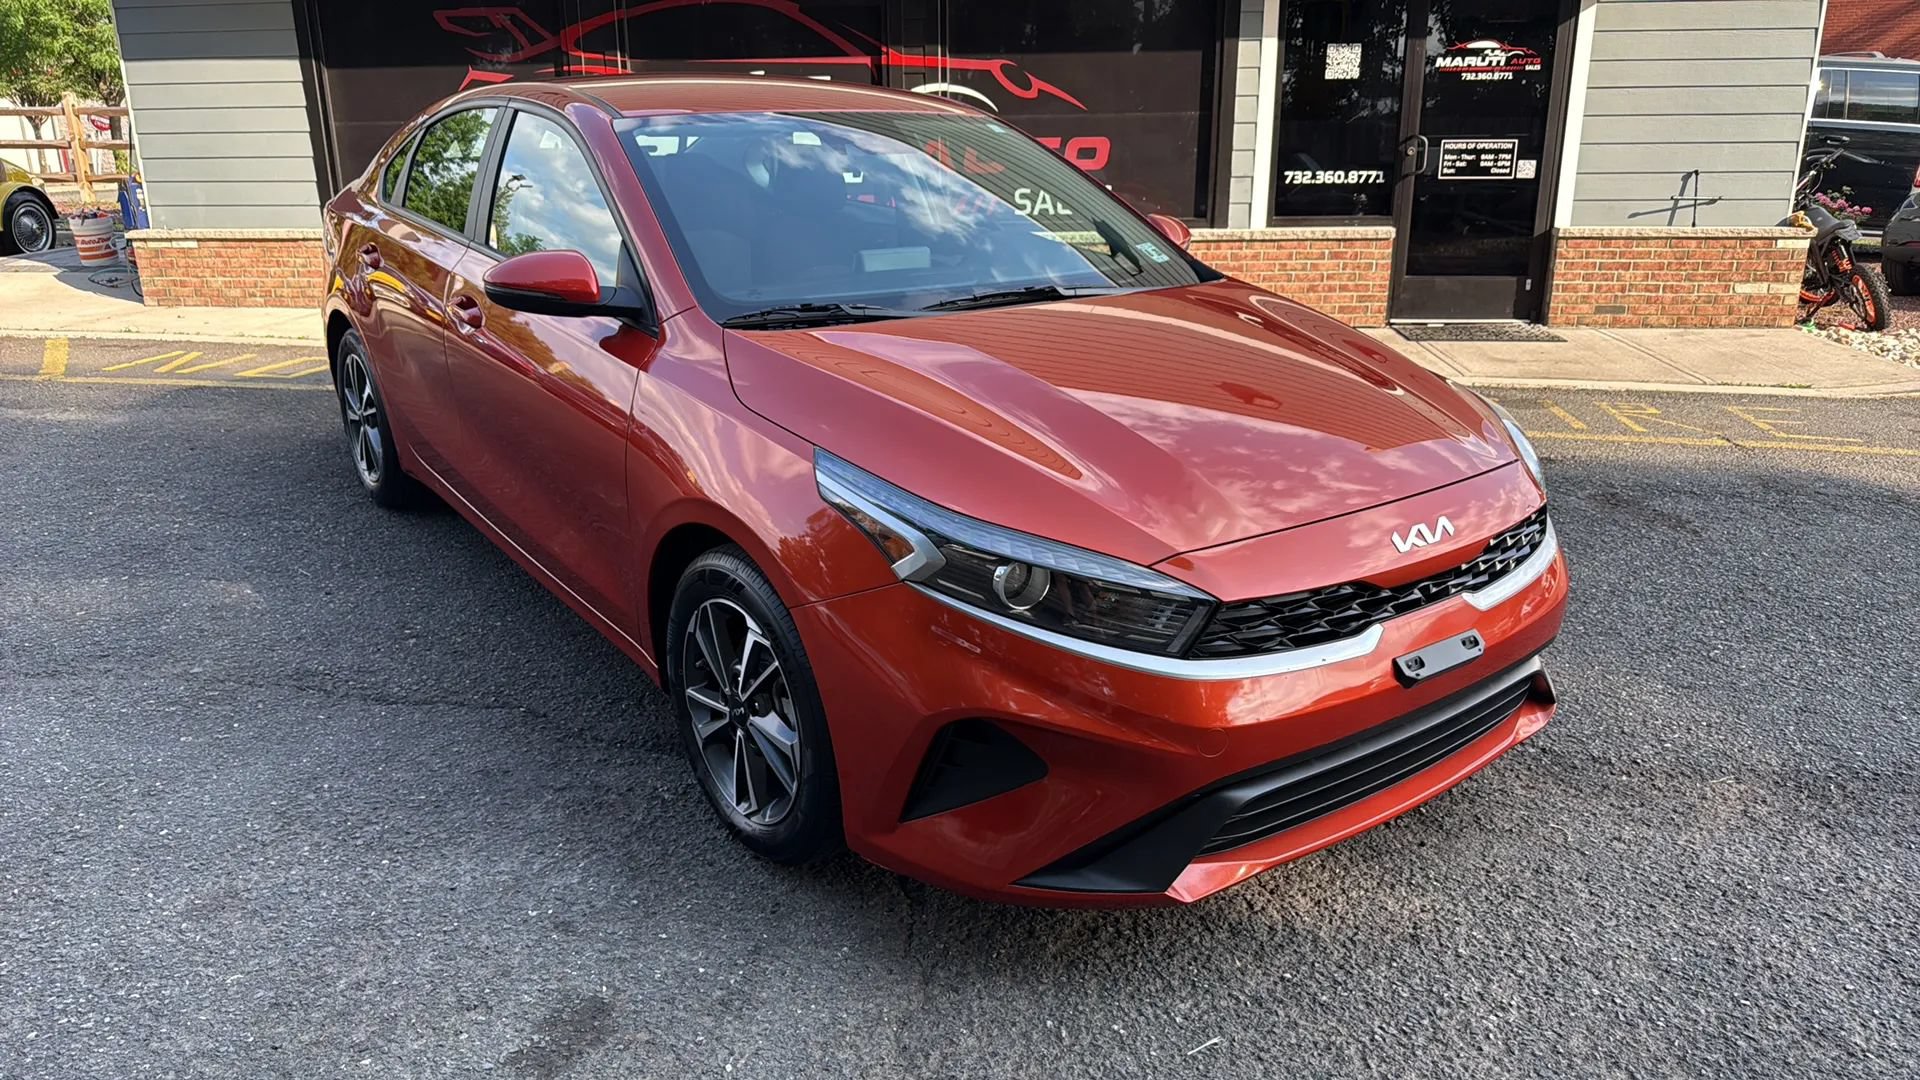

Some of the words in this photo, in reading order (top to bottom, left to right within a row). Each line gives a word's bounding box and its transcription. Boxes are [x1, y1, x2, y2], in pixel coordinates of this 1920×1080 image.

[1435, 56, 1506, 67] MARUTI
[1461, 72, 1513, 80] 732.360.8771
[922, 136, 1111, 173] AUO
[1283, 170, 1385, 184] 732.360.8771
[1493, 398, 1862, 443] IRE
[1391, 515, 1455, 553] KIA
